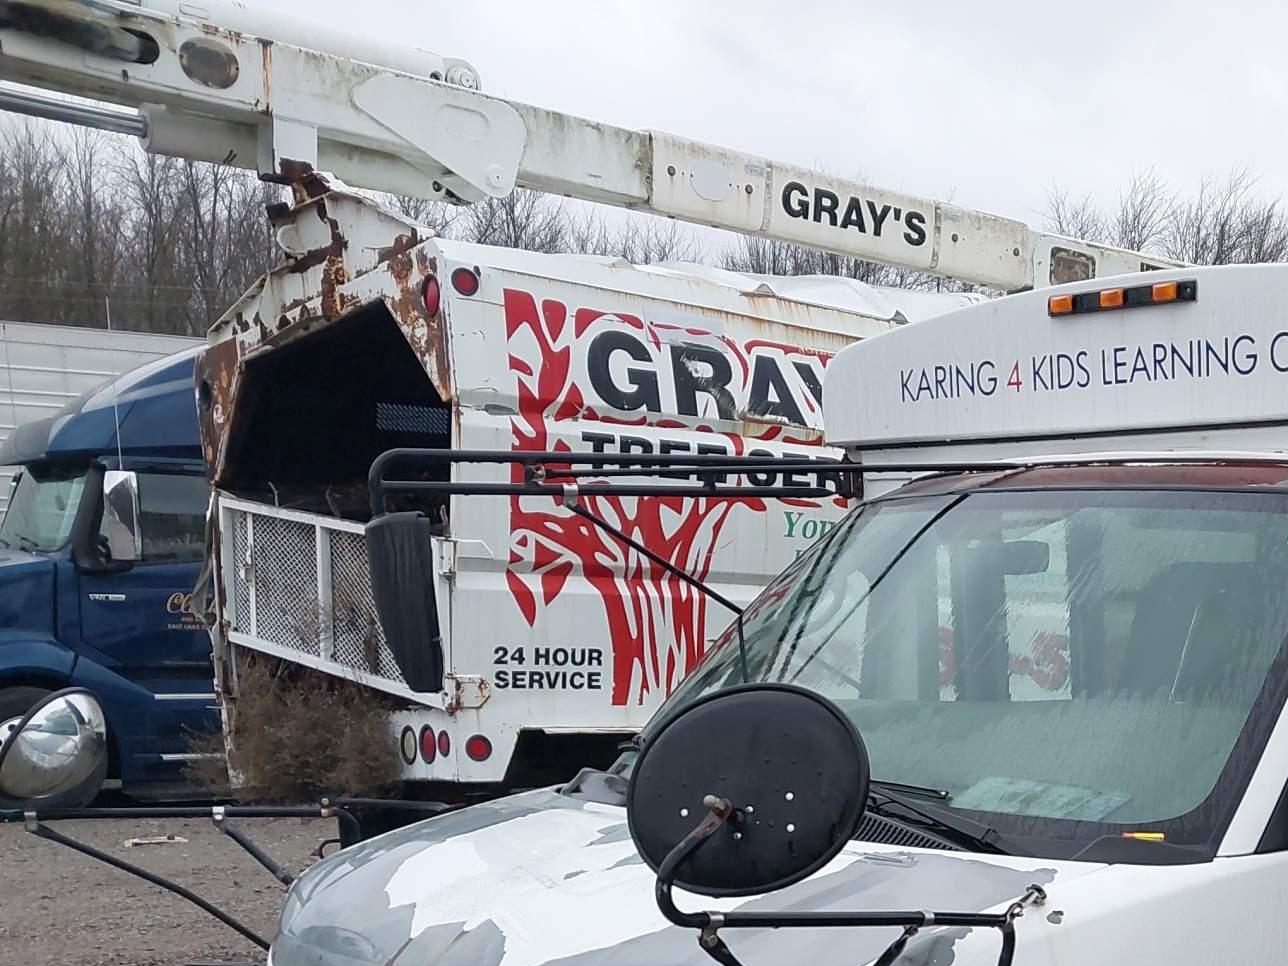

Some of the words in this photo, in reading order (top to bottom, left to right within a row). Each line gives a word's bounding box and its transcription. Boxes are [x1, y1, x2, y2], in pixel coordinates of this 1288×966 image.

[782, 181, 926, 246] GRAY'S
[900, 361, 998, 402] KARING
[1007, 359, 1023, 392] 4
[1032, 350, 1091, 391] KIDS
[1101, 335, 1258, 385] LEARNING
[493, 646, 526, 665] 24
[534, 647, 603, 666] HOUR
[494, 670, 602, 690] SERVICE
